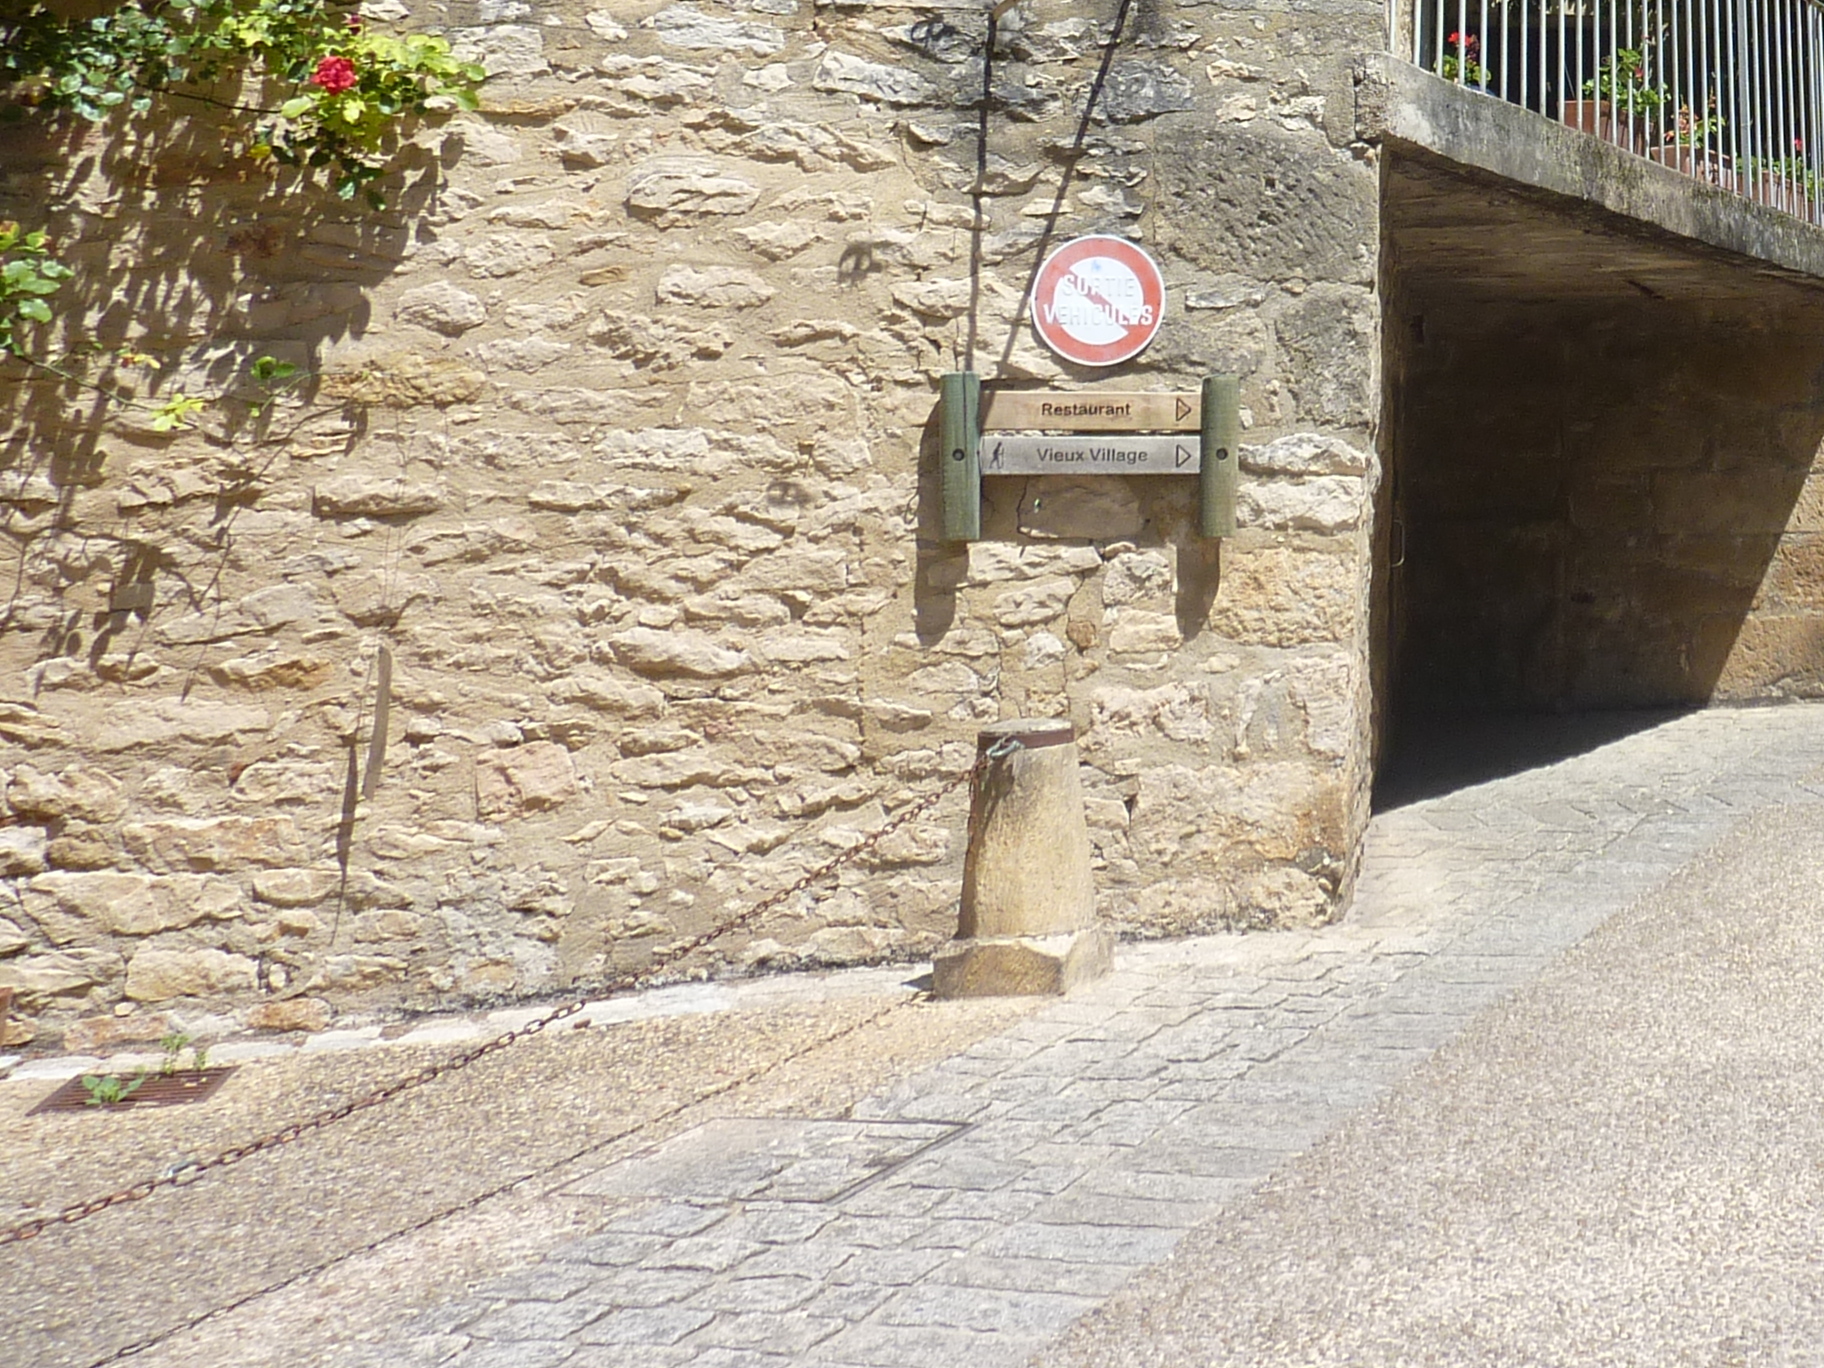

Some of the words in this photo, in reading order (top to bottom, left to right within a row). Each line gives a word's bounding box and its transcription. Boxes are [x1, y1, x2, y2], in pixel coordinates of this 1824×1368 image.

[1063, 275, 1136, 298] SORTIE
[1043, 303, 1154, 327] VEHICULES
[1041, 402, 1132, 418] Restaurant
[1036, 447, 1085, 463] Vieux
[1090, 447, 1148, 465] Village
